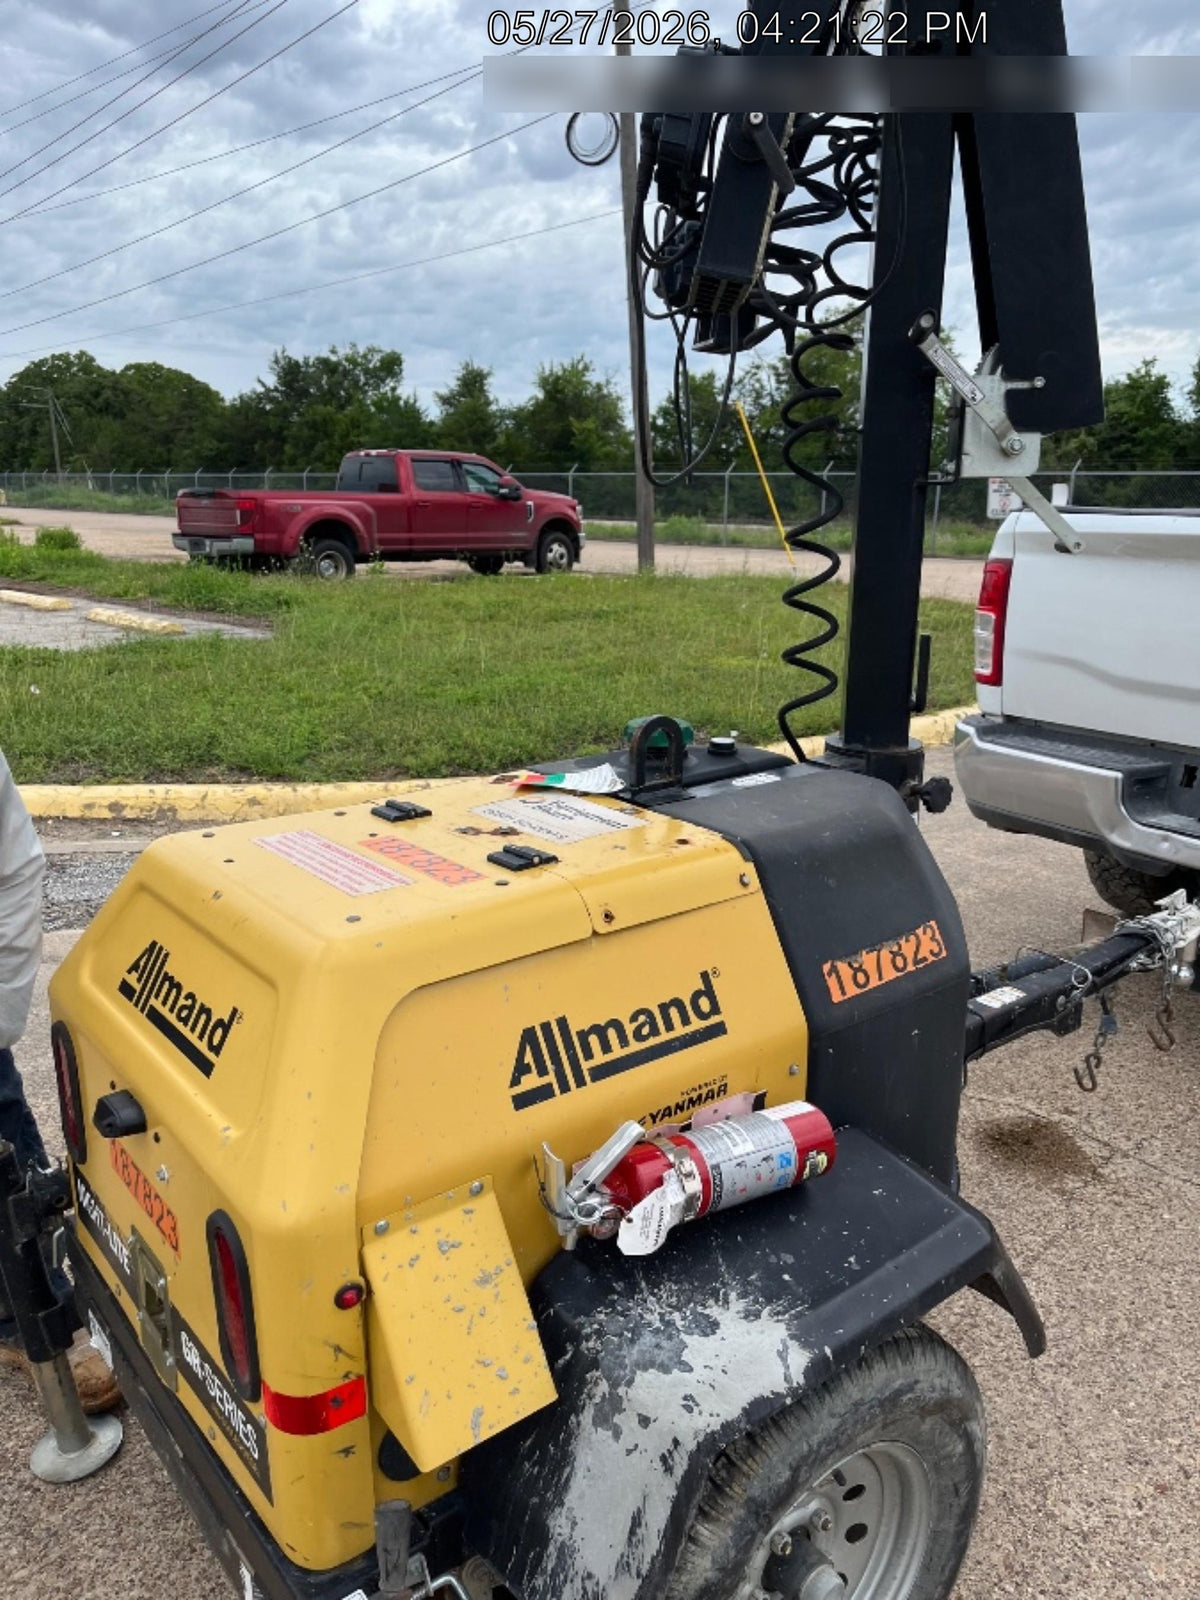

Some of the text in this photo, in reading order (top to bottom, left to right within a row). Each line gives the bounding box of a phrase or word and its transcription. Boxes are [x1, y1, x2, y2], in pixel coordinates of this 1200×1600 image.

[122, 939, 239, 1060] Allmand
[826, 922, 945, 998] 187823
[508, 969, 723, 1096] Allmand
[648, 1081, 728, 1125] YANMAR
